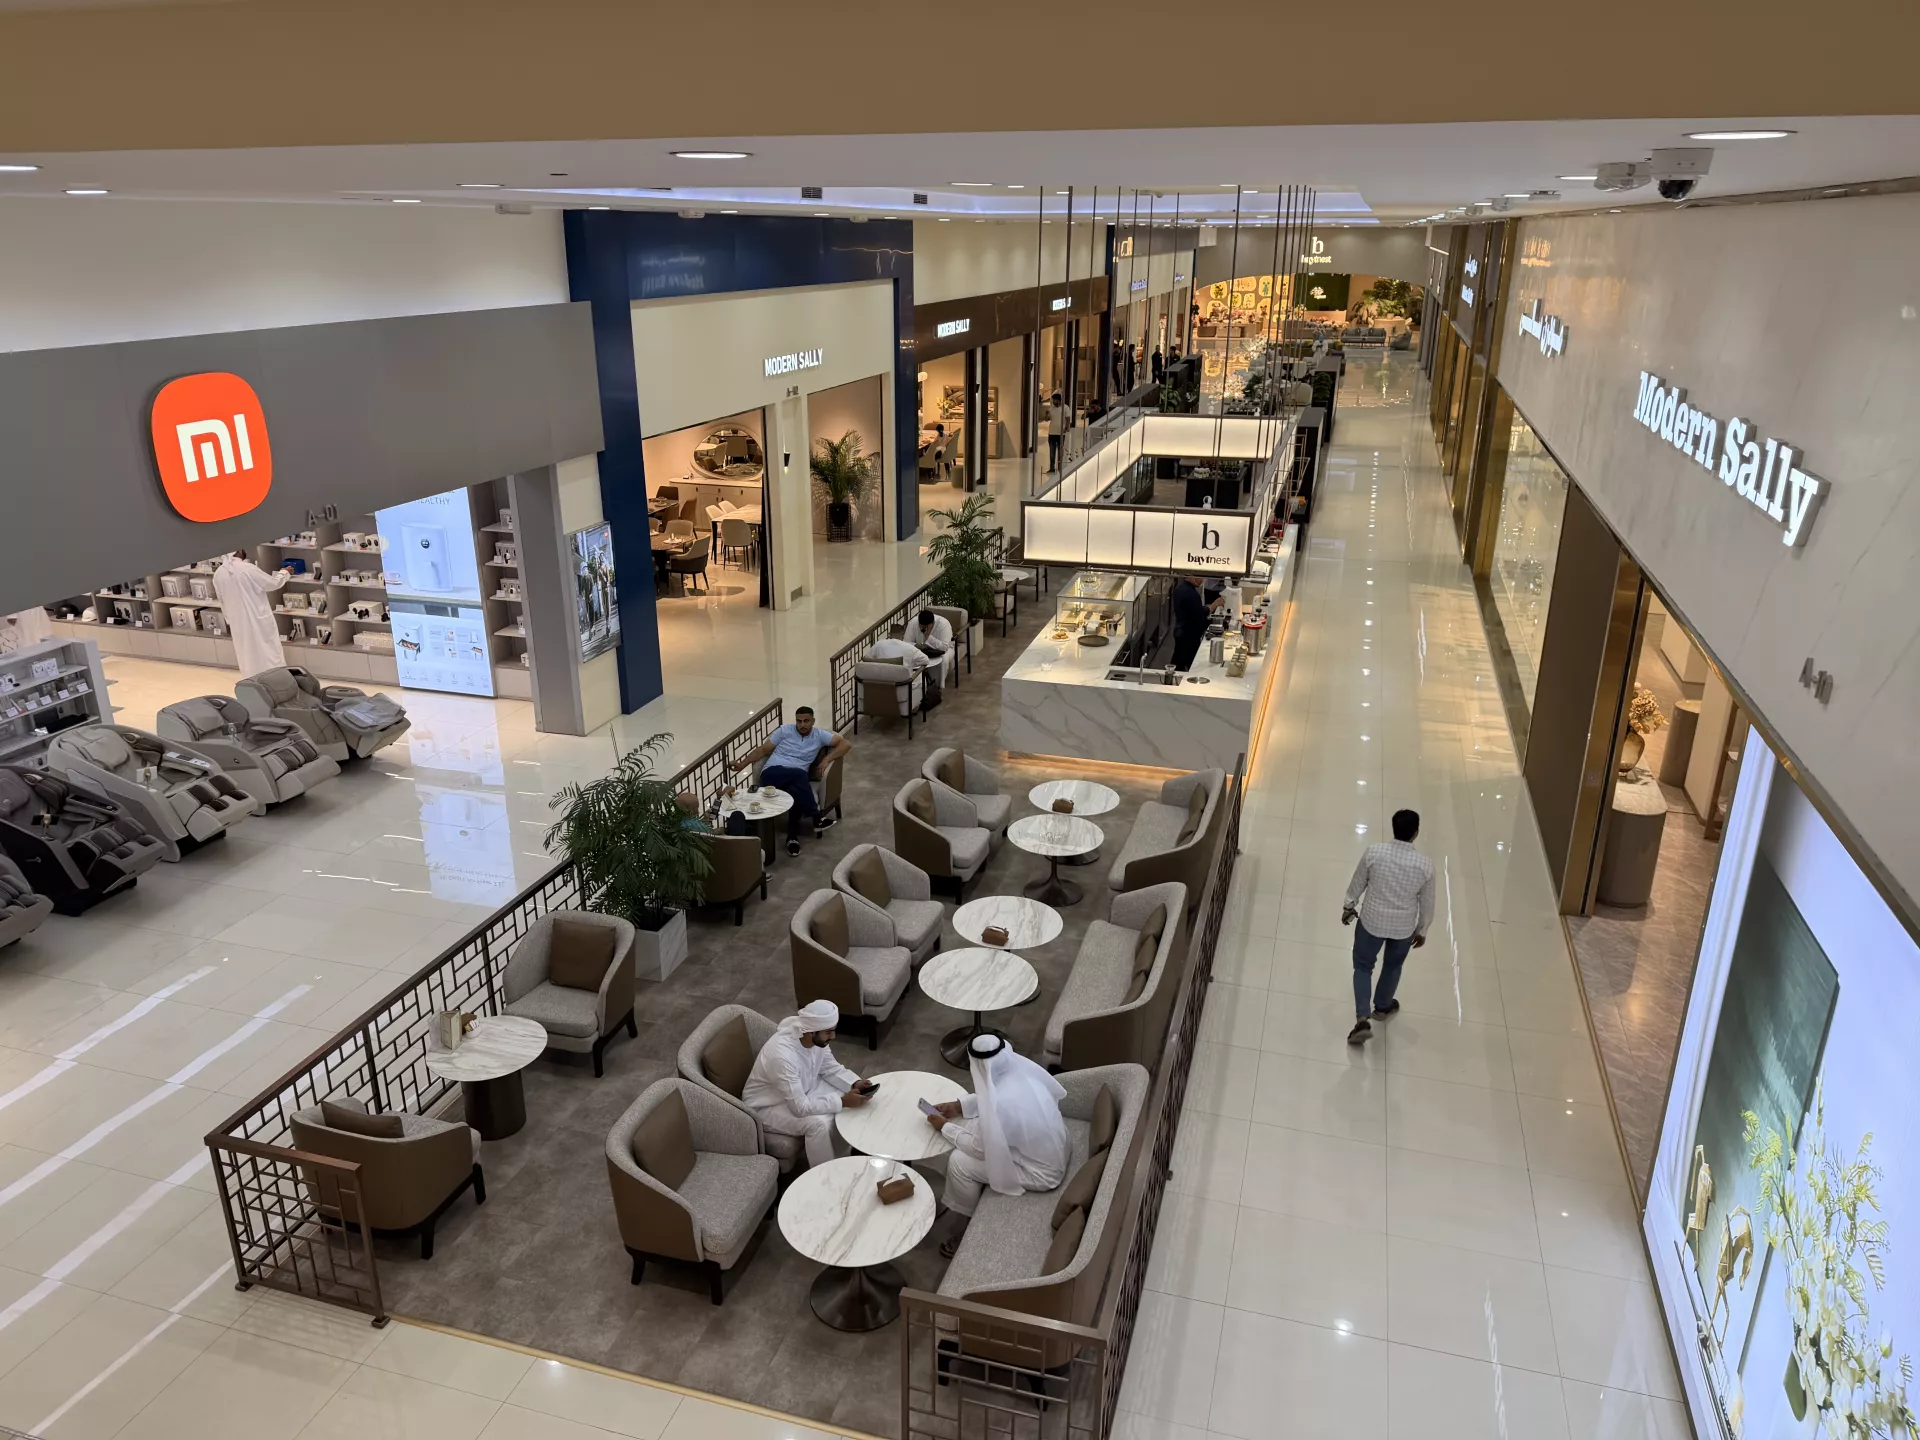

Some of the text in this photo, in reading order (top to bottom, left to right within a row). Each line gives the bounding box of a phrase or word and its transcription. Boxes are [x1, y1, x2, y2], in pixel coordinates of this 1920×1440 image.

[764, 347, 823, 377] MODERN SALLY
[1633, 370, 1820, 547] Modern Sally
[418, 496, 451, 505] EALTHY
[306, 503, 339, 528] A-01
